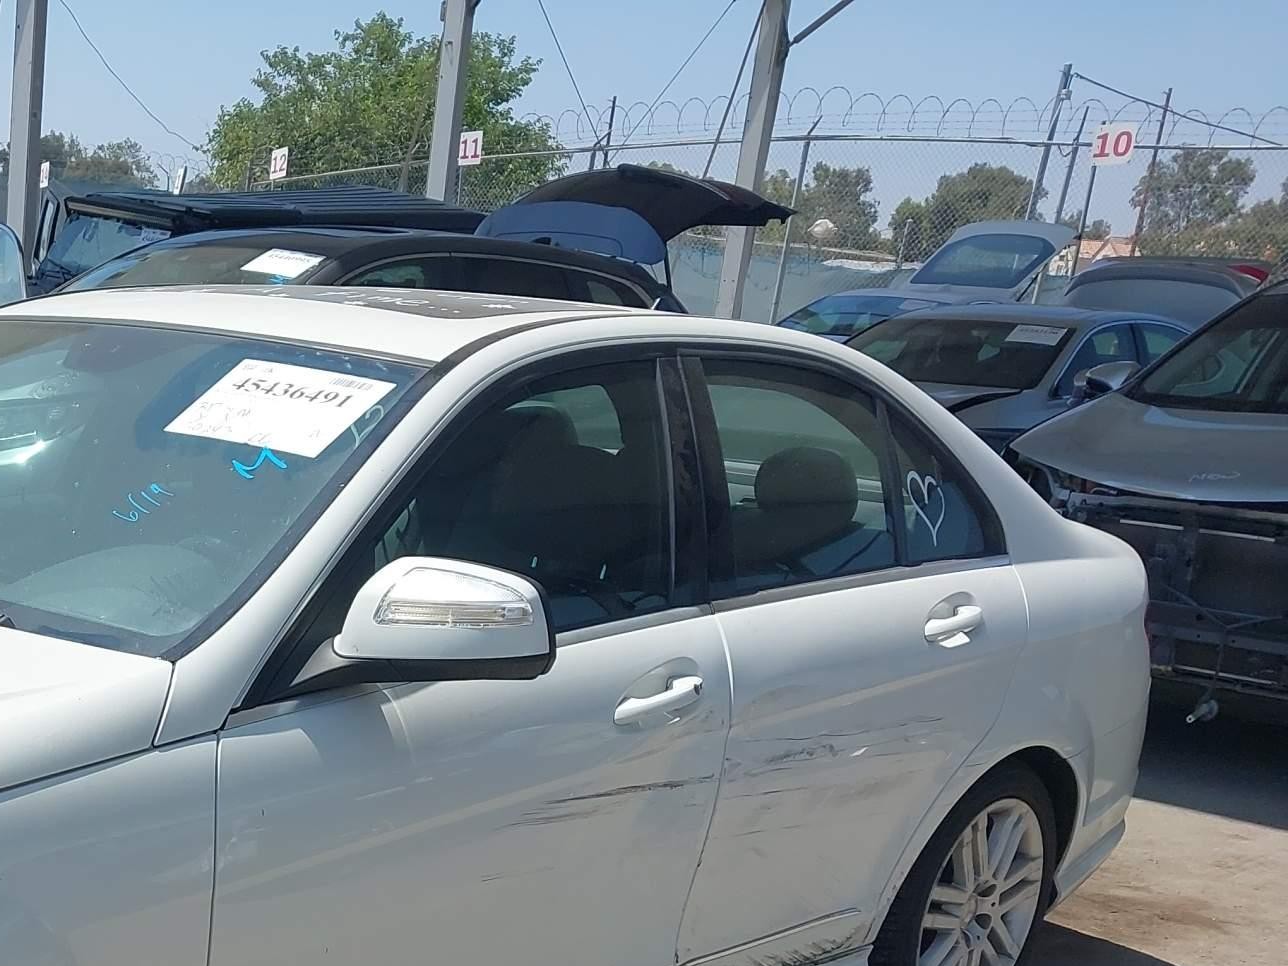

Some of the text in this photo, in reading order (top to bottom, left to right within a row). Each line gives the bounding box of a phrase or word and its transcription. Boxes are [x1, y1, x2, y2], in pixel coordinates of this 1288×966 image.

[460, 137, 480, 159] 11
[1093, 131, 1133, 158] 10
[272, 153, 287, 173] 12
[232, 377, 354, 408] 45436491
